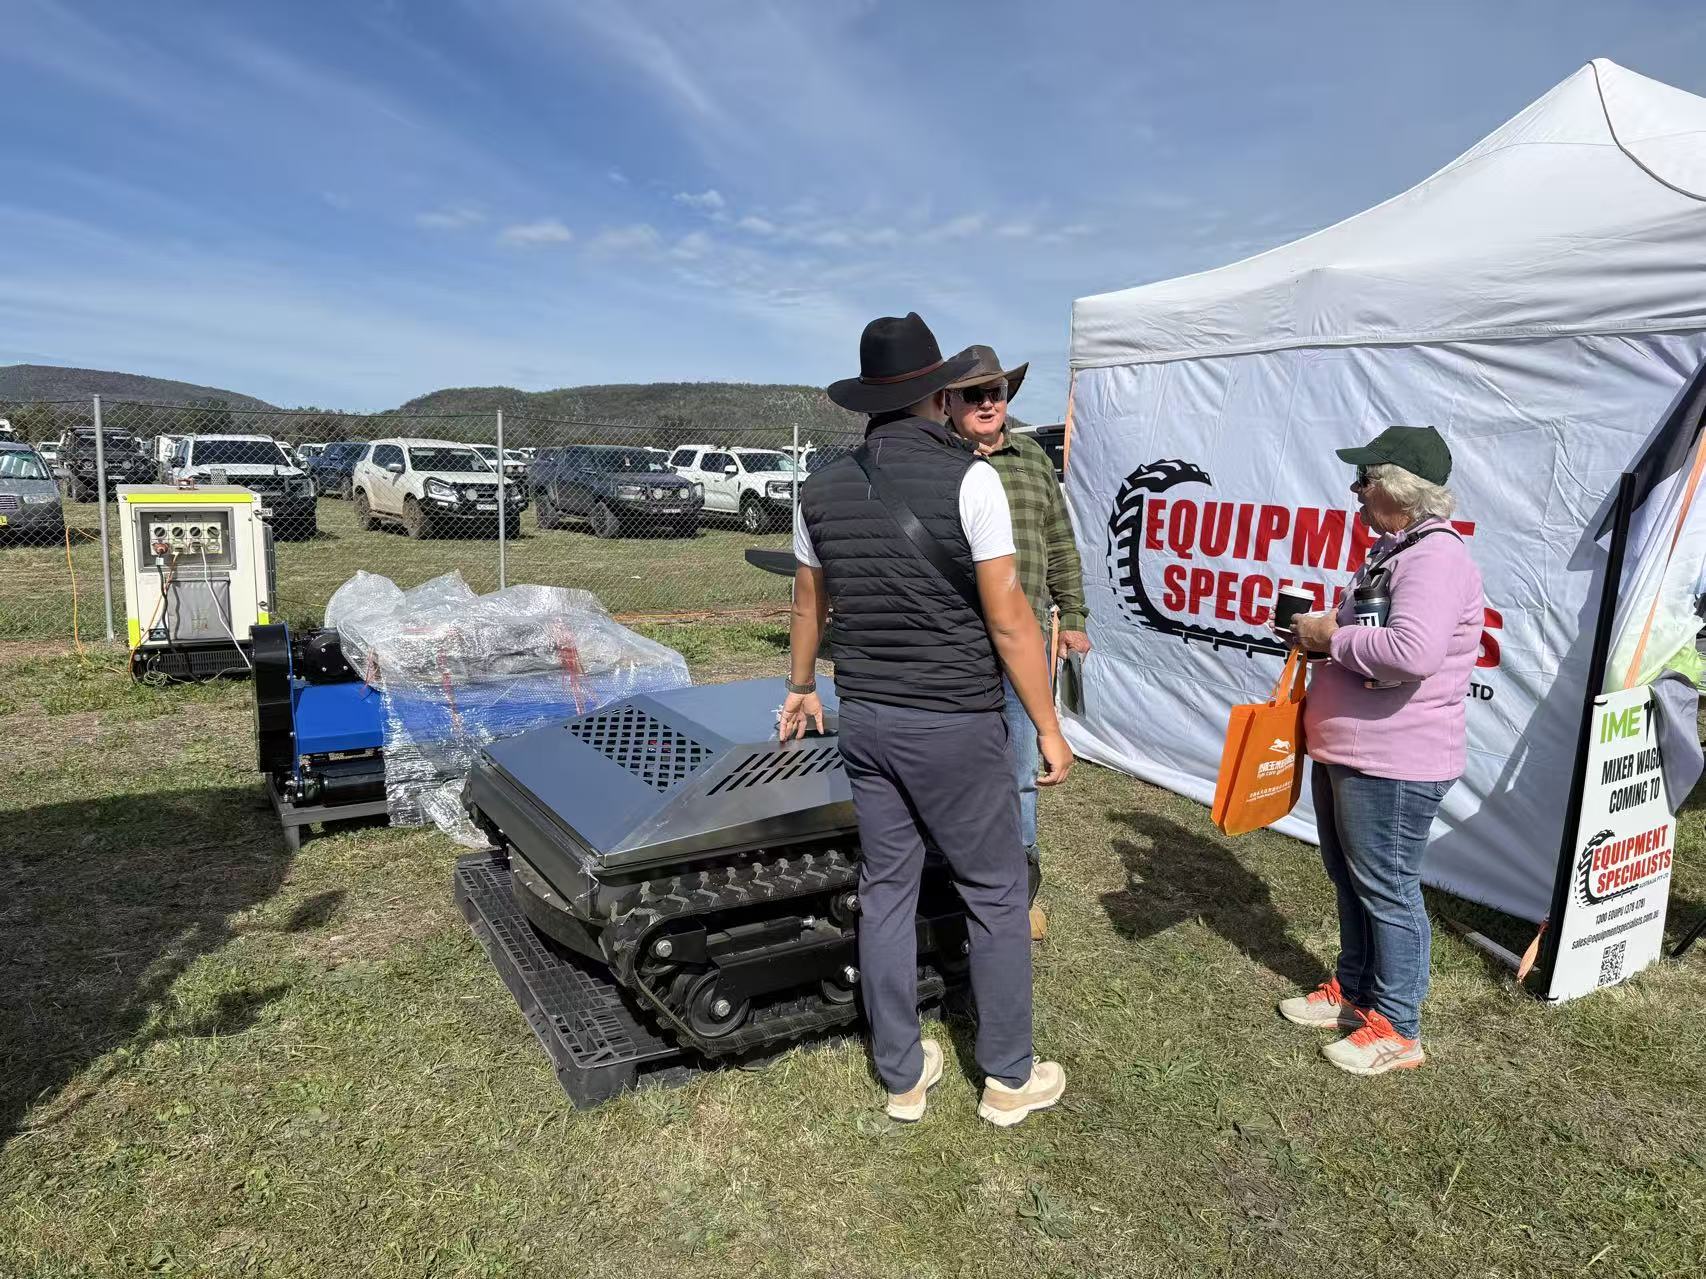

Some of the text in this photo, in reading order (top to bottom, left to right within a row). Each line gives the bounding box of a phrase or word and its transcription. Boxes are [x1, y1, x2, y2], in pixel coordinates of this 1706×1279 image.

[1466, 682, 1495, 701] TD
[1601, 754, 1635, 786] MIXER
[1609, 776, 1661, 814] COMING TO
[1592, 824, 1668, 872] EQUIPMENT
[1596, 848, 1672, 894] SPECIALISTS
